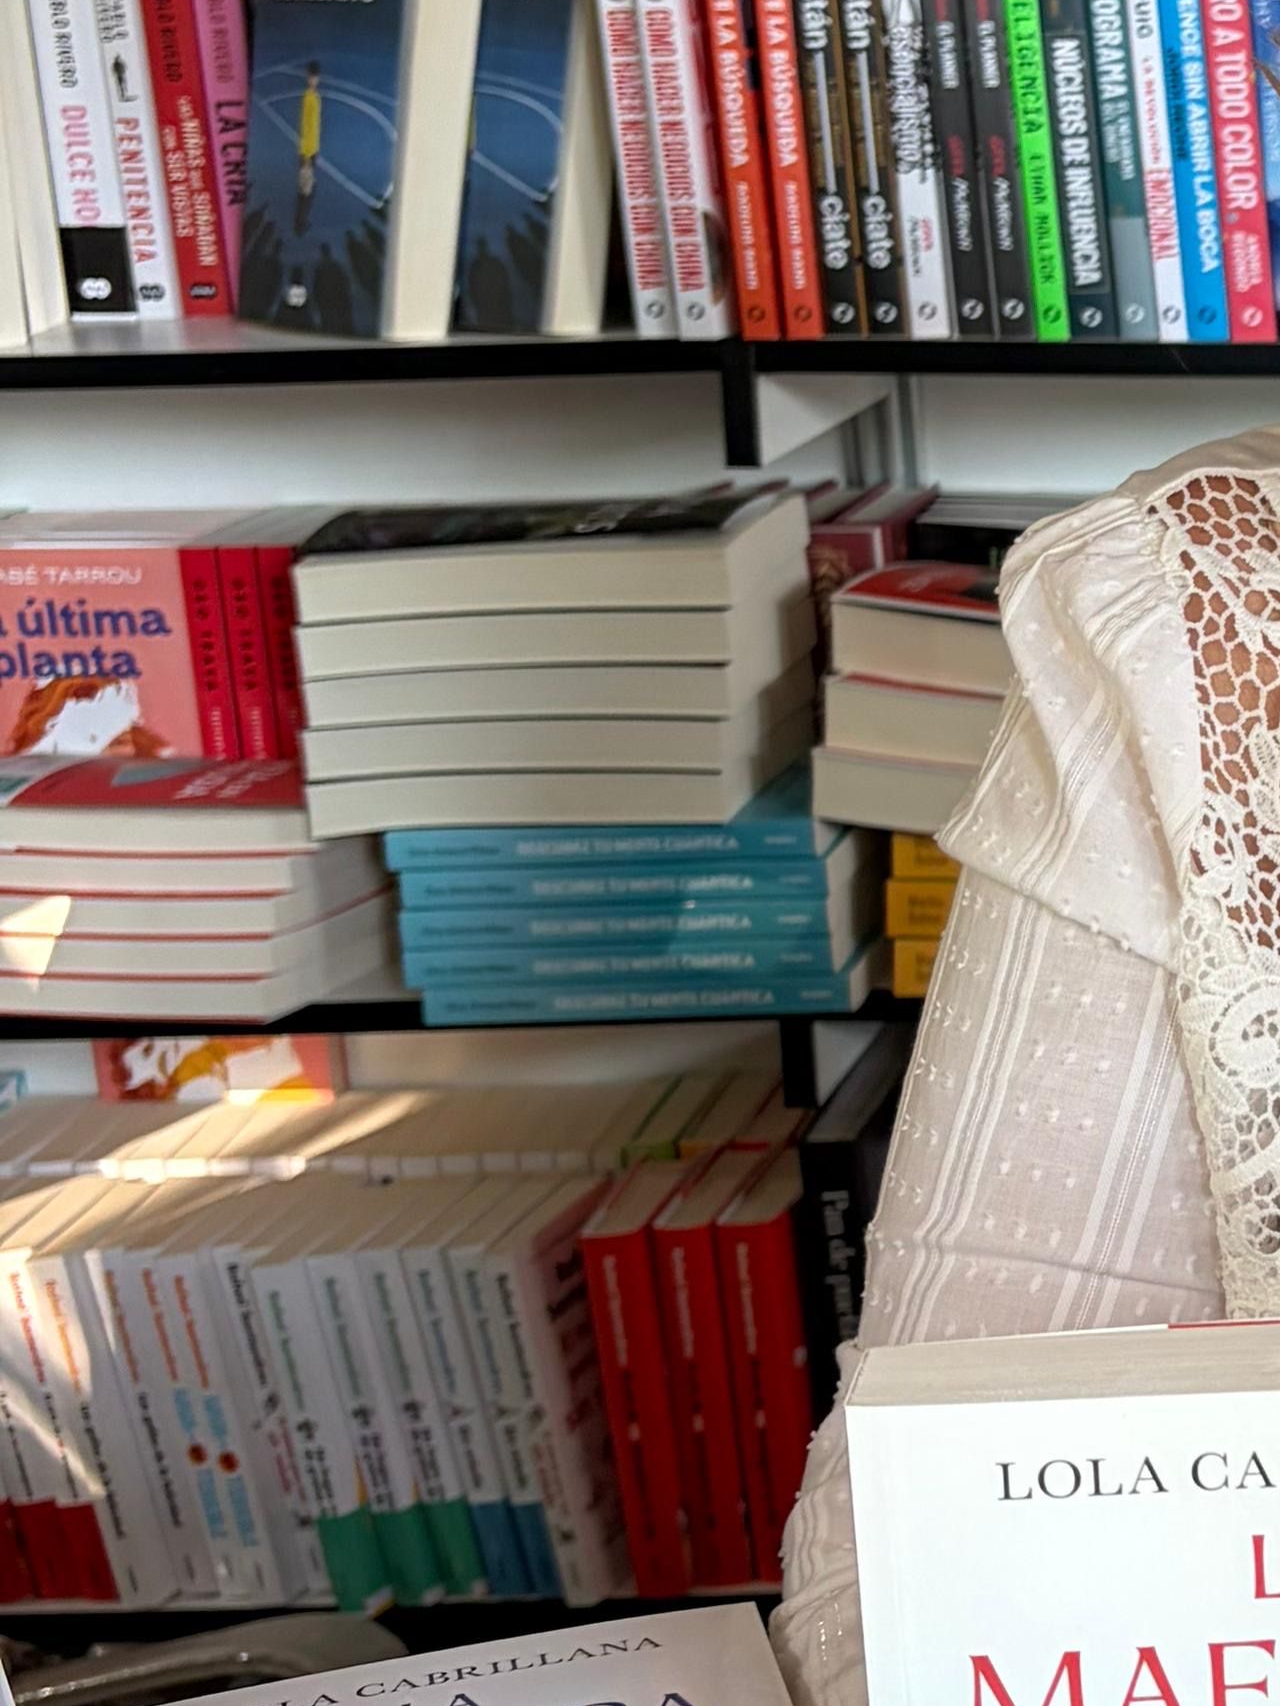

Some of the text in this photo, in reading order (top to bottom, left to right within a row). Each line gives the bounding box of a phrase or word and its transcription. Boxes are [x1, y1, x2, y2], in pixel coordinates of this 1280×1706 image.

[1212, 30, 1242, 46] A
[1214, 52, 1250, 119] TODO
[1220, 129, 1259, 210] COLOR
[17, 596, 172, 637] última
[996, 1456, 1169, 1501] LOLA
[355, 1637, 661, 1698] CABRILLANA
